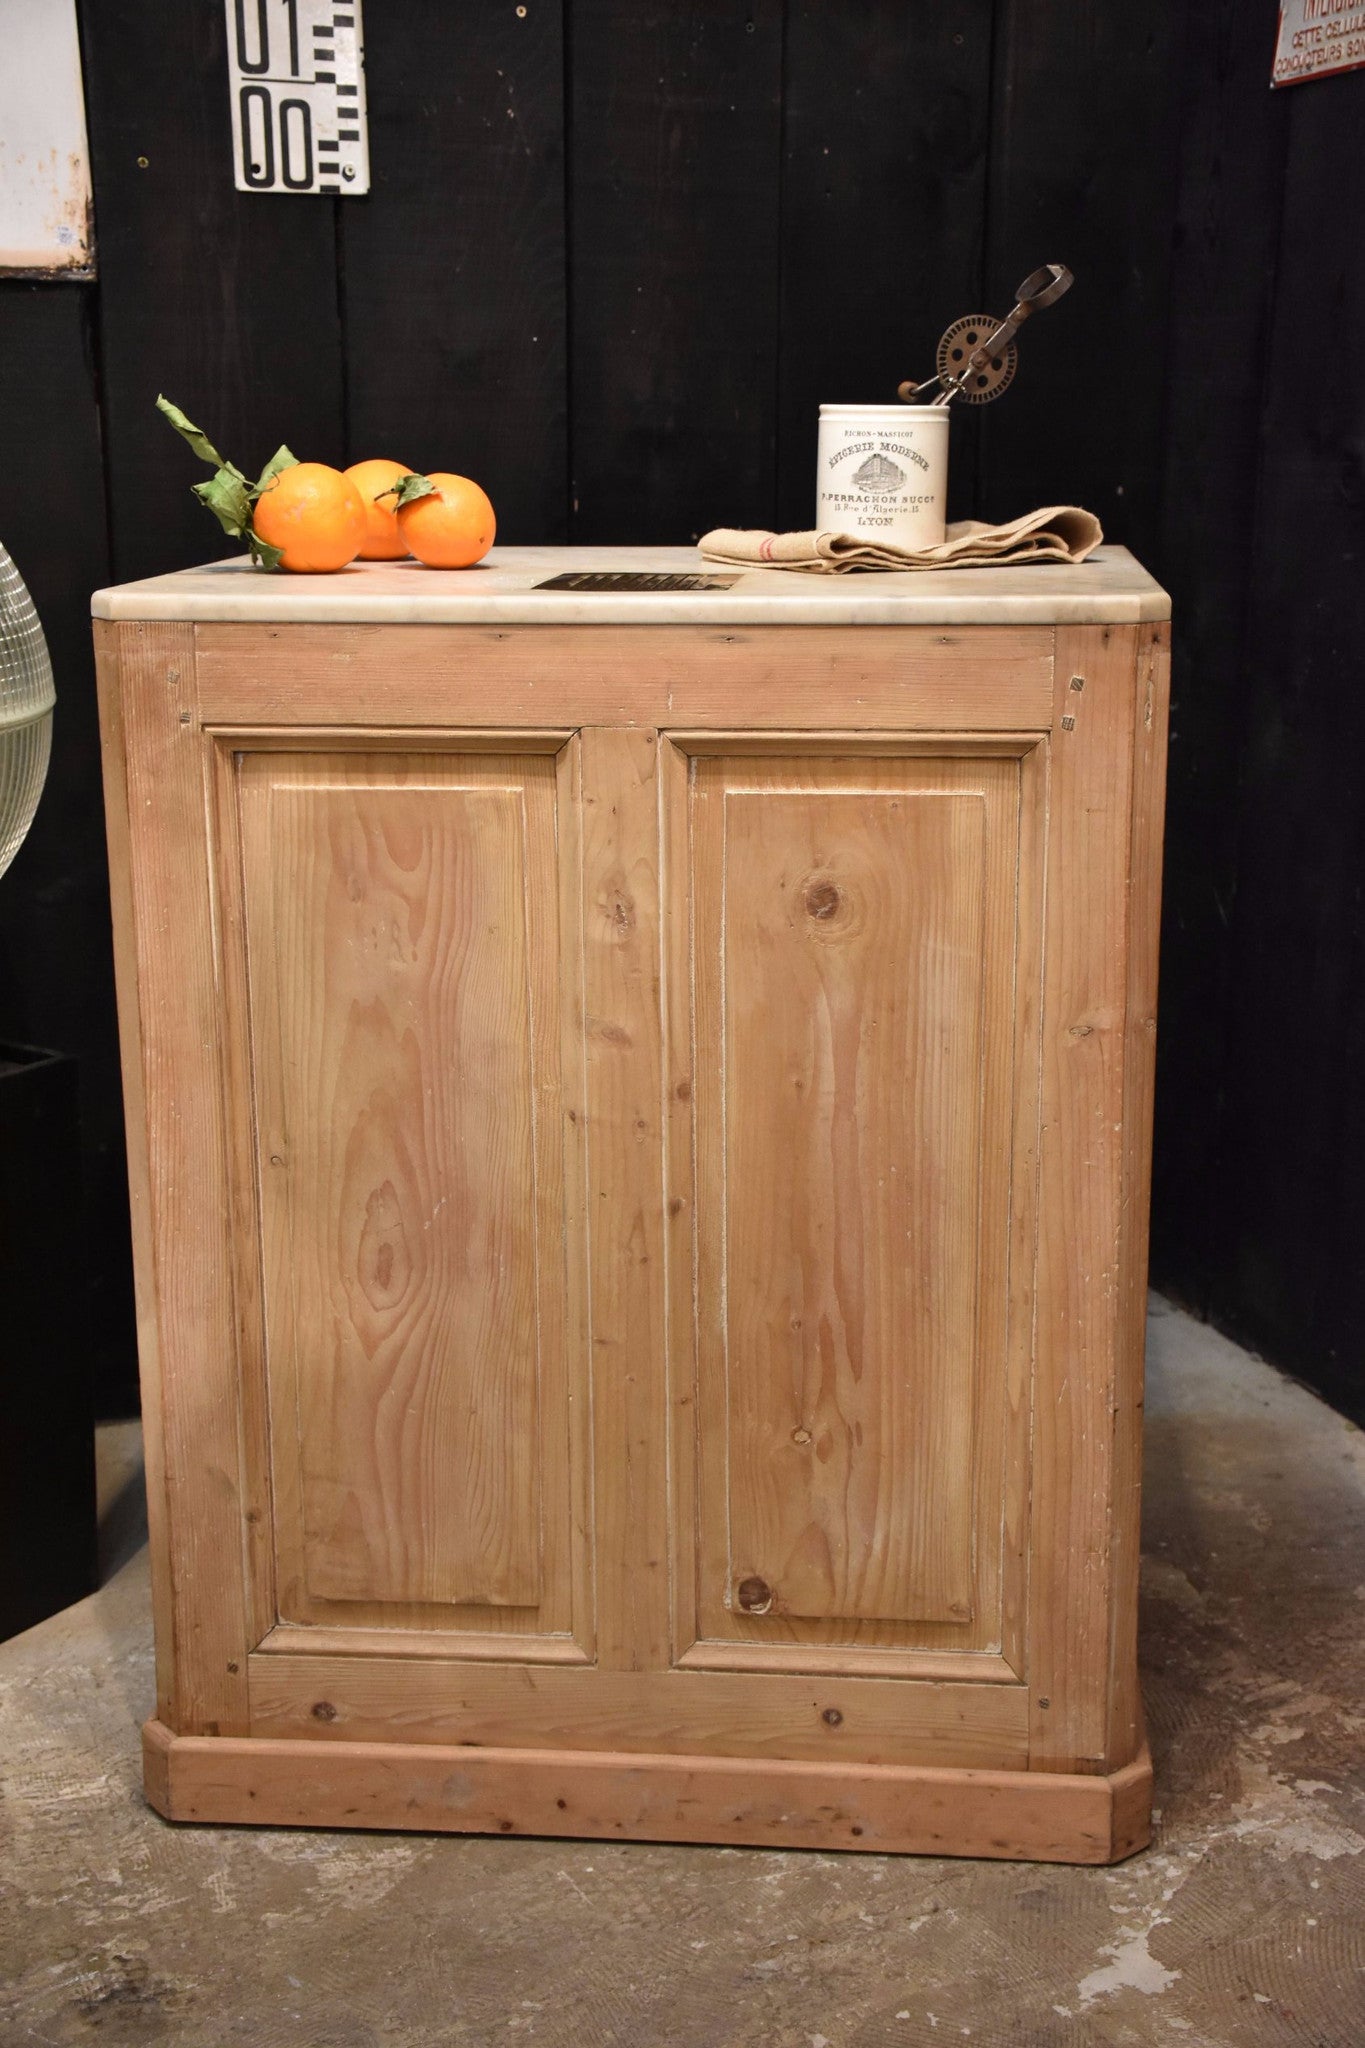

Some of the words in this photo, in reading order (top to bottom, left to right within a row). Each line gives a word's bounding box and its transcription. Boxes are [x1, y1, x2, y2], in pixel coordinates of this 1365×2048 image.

[1292, 26, 1322, 50] CETTE
[239, 85, 314, 190] 00
[879, 441, 930, 472] MODERNE
[857, 516, 894, 527] LYON
